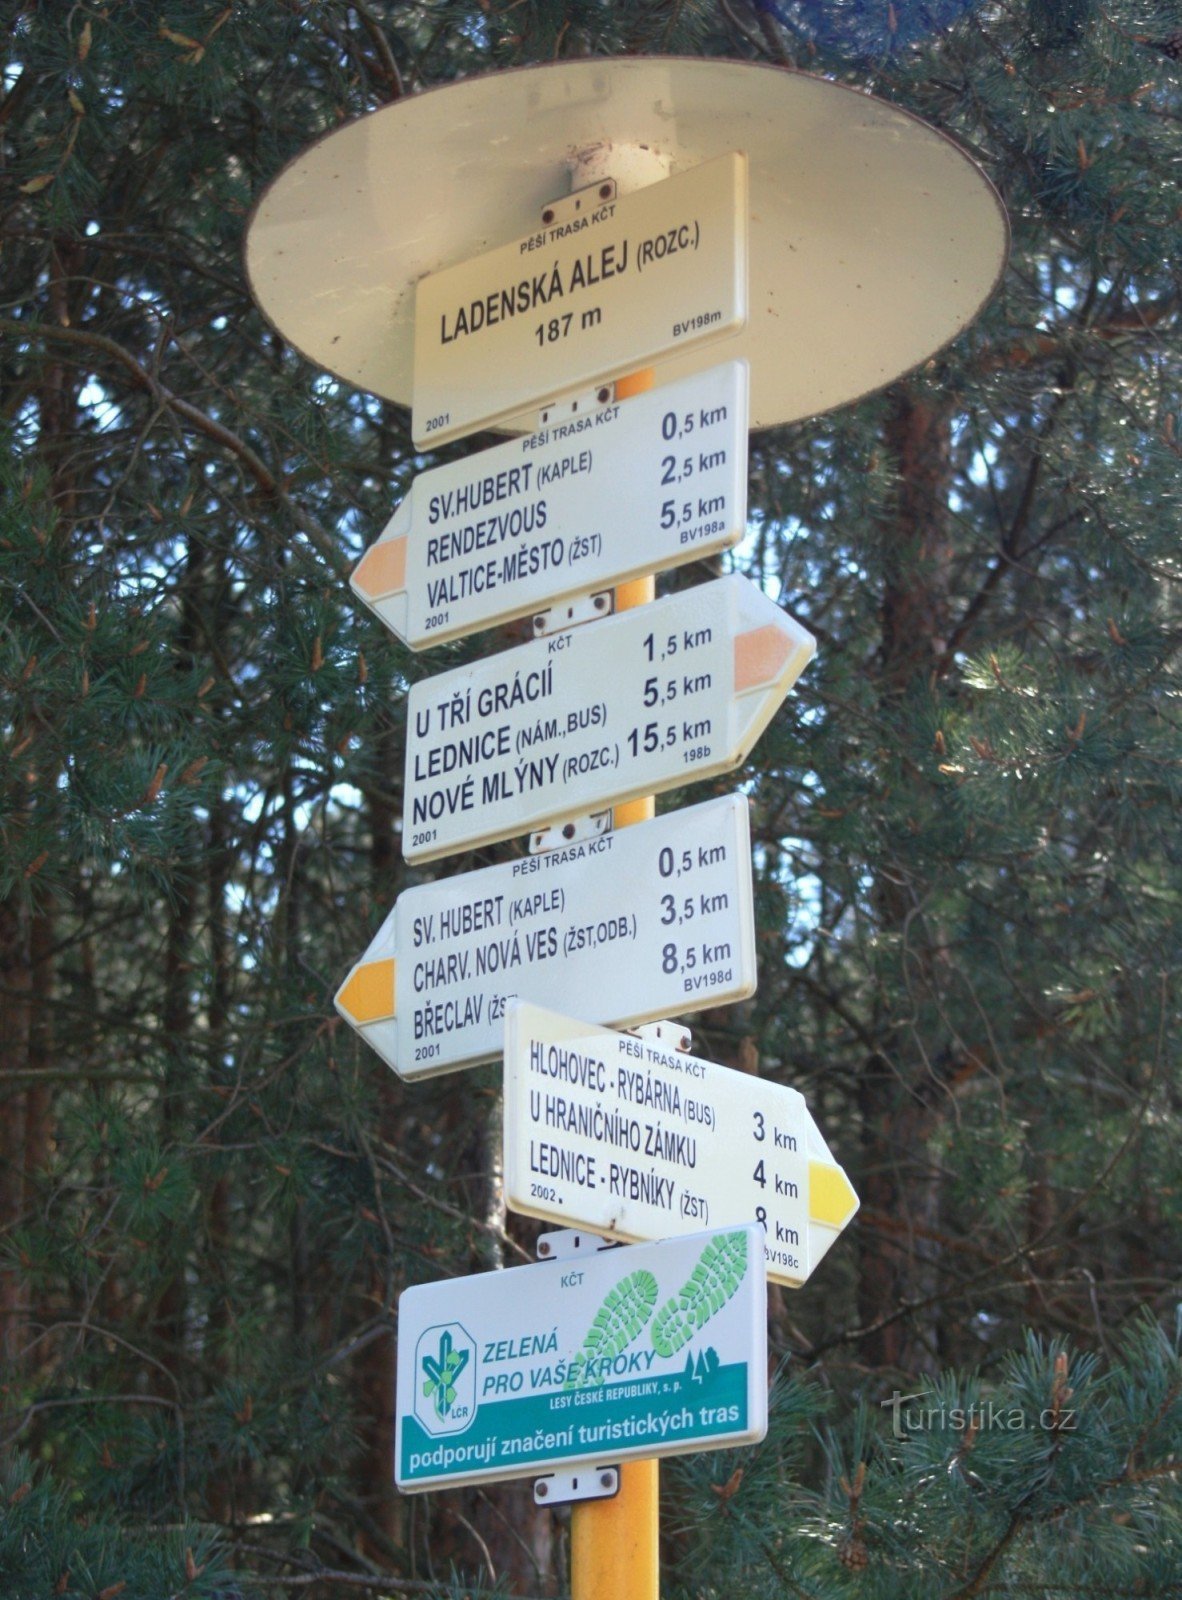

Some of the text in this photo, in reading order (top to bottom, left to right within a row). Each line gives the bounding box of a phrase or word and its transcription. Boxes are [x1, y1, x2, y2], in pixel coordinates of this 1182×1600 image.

[520, 205, 615, 254] PĚŠÍ TRASA KČT
[441, 221, 699, 344] LADENSKÁ ALEJ (ROZC.)
[535, 307, 601, 345] 187 m
[673, 311, 721, 337] BV198m
[426, 414, 450, 431] 2001
[523, 407, 619, 451] PĚŠÍ TRASA KČT
[537, 450, 592, 490] (KAPLE)
[662, 412, 694, 440] 0,5
[700, 406, 727, 427] km
[427, 450, 726, 566] RENDEZVOUS 2,5 km
[427, 496, 725, 608] VALTICE-MĚSTO (ŽST) 5,5 km
[680, 520, 725, 544] BV198a
[425, 613, 449, 629] 2001
[548, 635, 572, 653] KČT
[416, 628, 711, 737] U TŘÍ GRÁCIÍ 1,5 km
[415, 726, 510, 781] LEDNICE
[644, 677, 676, 707] 5,5
[684, 674, 711, 695] km
[412, 720, 711, 825] NOVÉ MLÝNY (ROZC.) 15,5 km
[683, 745, 710, 763] 198b
[412, 830, 437, 846] 2001
[513, 837, 614, 877] PĚŠÍ TRASA KČT
[414, 845, 726, 947] SV. HUBERT (KAPLE) 0,5 km
[414, 956, 471, 992] CHARV.
[476, 930, 521, 976] NOVÁ
[526, 927, 557, 961] VES
[661, 895, 694, 925] 3,5
[701, 892, 728, 915] km
[414, 994, 483, 1039] BŘECLAV
[662, 944, 695, 974] 8,5
[703, 941, 731, 964] km
[684, 969, 732, 992] BV198d
[415, 1044, 440, 1060] 2001
[619, 1040, 706, 1079] PĚŠÍ TRASA KČT
[531, 1040, 606, 1093] HLOHOVEC
[618, 1068, 681, 1117] RYBÁRNA
[684, 1099, 716, 1131] (BUS)
[753, 1112, 764, 1141] 3
[774, 1128, 797, 1151] km
[531, 1090, 797, 1198] U HRANIČNÍHO ZÁMKU 4 km
[531, 1140, 595, 1189] LEDNICE
[610, 1164, 674, 1210] RYBNÍKY
[680, 1193, 708, 1225] (ŽST)
[776, 1221, 798, 1246] km
[561, 1273, 584, 1288] KČT
[483, 1327, 558, 1363] ZELENÁ
[483, 1350, 656, 1396] PRO VAŠE KROKY
[452, 1406, 468, 1420] LČR
[550, 1396, 572, 1409] LESY
[574, 1390, 603, 1406] ČESKÉ
[606, 1383, 661, 1401] REPUBLIKY,
[410, 1404, 739, 1473] podporují značení turistických tras
